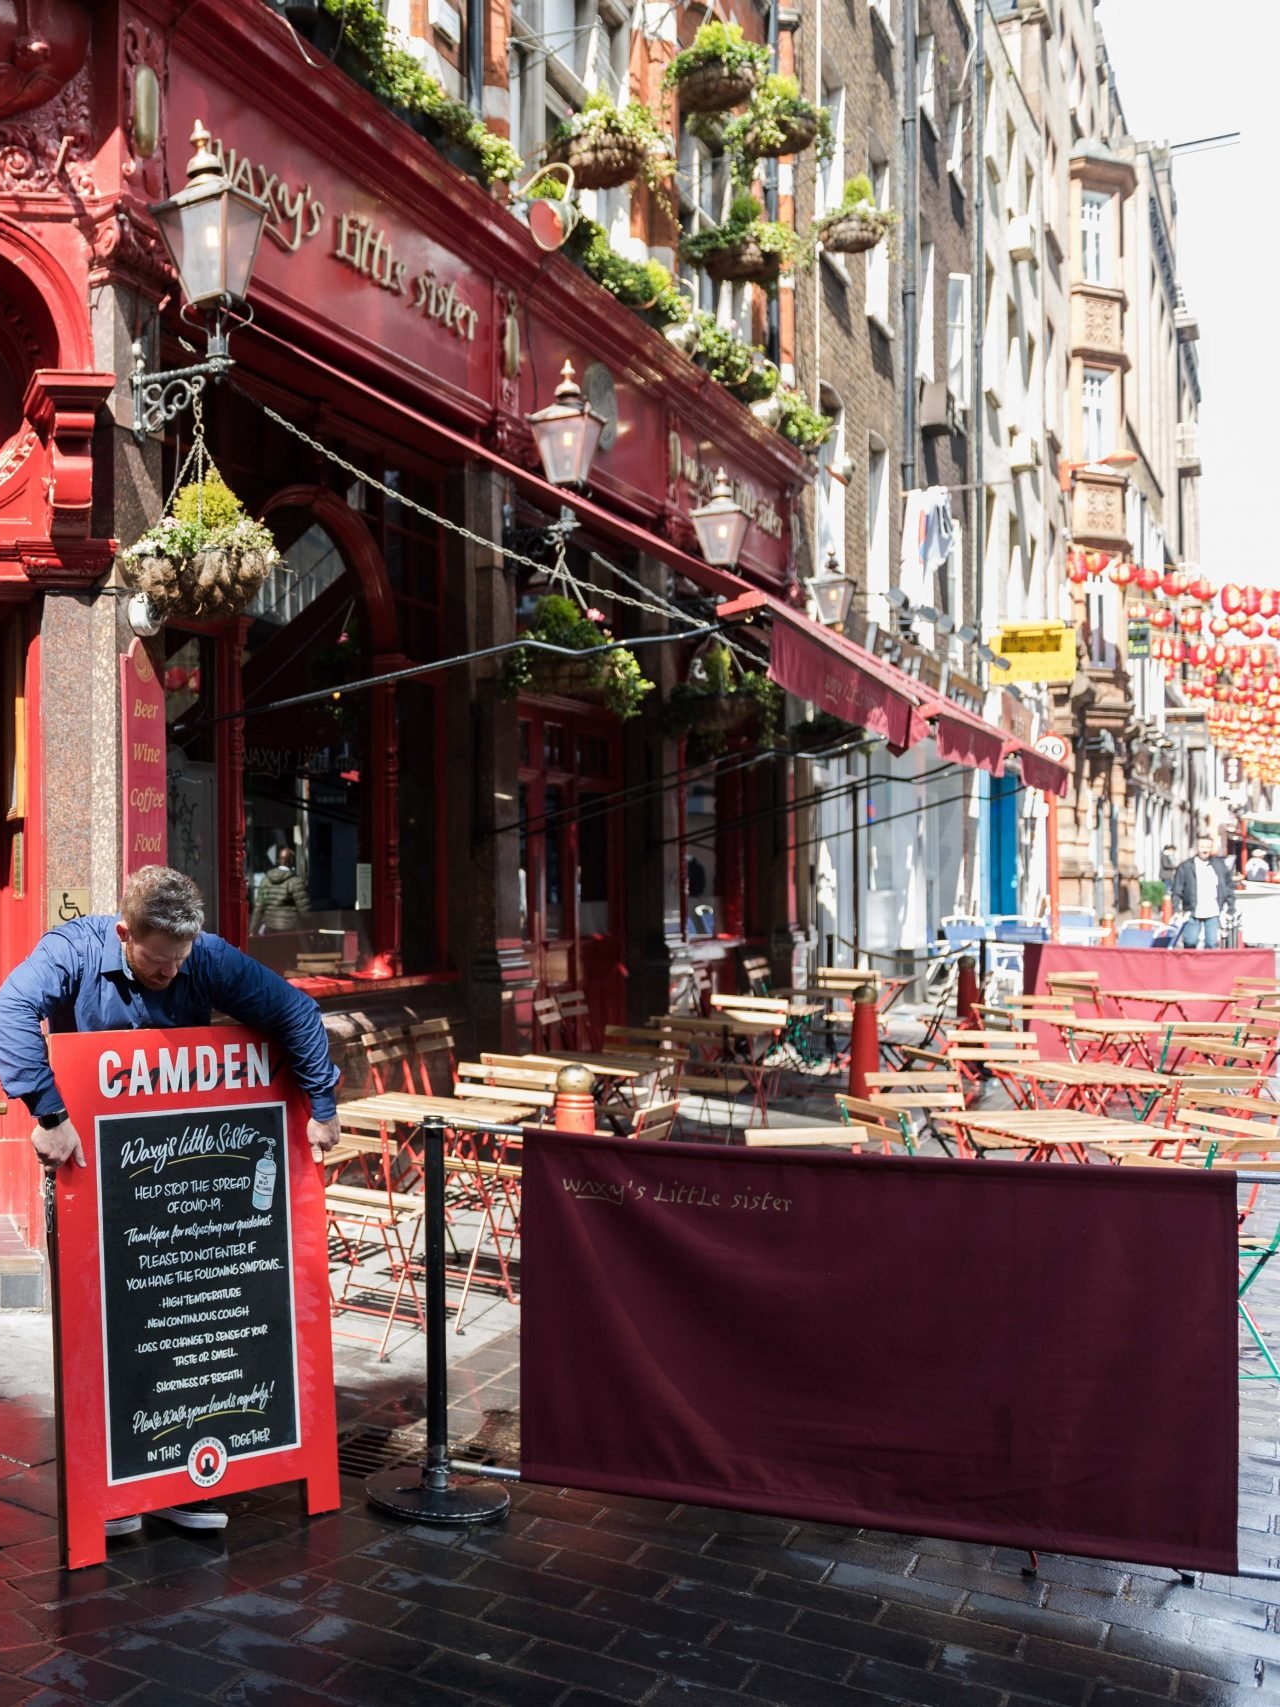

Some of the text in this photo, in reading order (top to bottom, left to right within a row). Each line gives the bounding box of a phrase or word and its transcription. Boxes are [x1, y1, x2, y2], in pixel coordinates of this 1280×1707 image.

[134, 699, 159, 719] Beer
[133, 743, 160, 764] Wine
[1038, 742, 1063, 756] 20
[130, 788, 165, 813] Coffee
[134, 833, 161, 853] Food
[98, 1042, 270, 1099] CAMDEN
[121, 1136, 177, 1174] Waxy's
[134, 1176, 251, 1200] HELP STOP THE SPREAD
[167, 1201, 181, 1214] OF
[170, 1223, 184, 1244] for
[222, 1222, 235, 1232] our
[139, 1240, 257, 1270] PLEASE DO NOT ENTER IF
[126, 1278, 147, 1291] YOU
[148, 1274, 175, 1288] HAVE
[176, 1271, 193, 1284] THE
[194, 1265, 239, 1280] FOLLOWING
[162, 1287, 242, 1309] HIGH TEMPERATURE
[147, 1305, 250, 1329] NEW CONTINUOUS COUGH
[138, 1324, 269, 1354] LOSS OR CHANGE TO SENSE OF YOUR
[173, 1354, 198, 1367] TASTE
[198, 1351, 210, 1363] OR
[156, 1368, 243, 1394] SHORTNESS OF BREATH
[132, 1410, 162, 1434] Please
[186, 1403, 209, 1429] your
[208, 1392, 236, 1414] hands
[147, 1427, 271, 1462] IN THIS TOGETHER
[190, 1440, 210, 1461] CAMDEN
